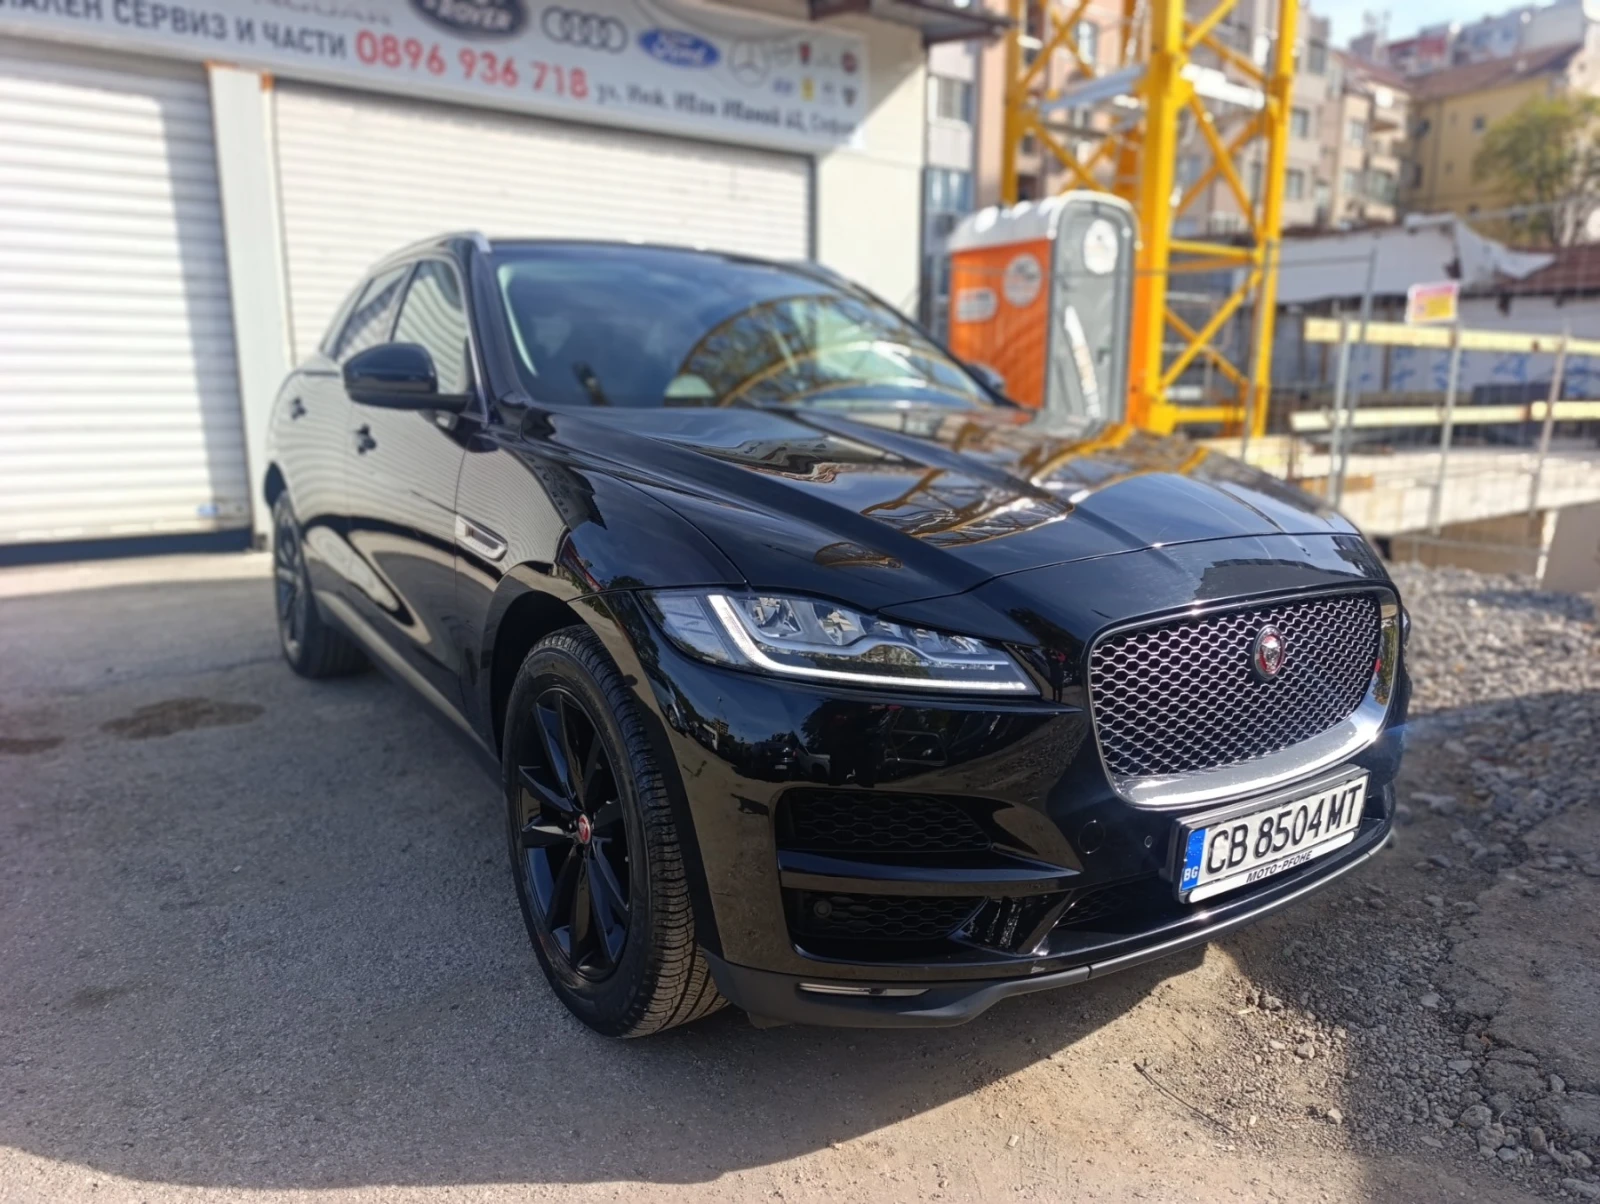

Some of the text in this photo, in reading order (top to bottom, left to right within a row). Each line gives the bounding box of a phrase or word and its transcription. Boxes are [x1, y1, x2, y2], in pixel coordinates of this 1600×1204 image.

[112, 0, 228, 40] СЕРВИЗ
[235, 17, 256, 45] И
[262, 21, 348, 60] ЧАСТИ
[355, 29, 446, 76] 0896
[458, 47, 520, 88] 936
[530, 60, 589, 100] 718
[1206, 783, 1363, 875] CB 8504 MT
[1183, 866, 1199, 882] BG
[1246, 850, 1313, 883] MOTO-PFOHE
